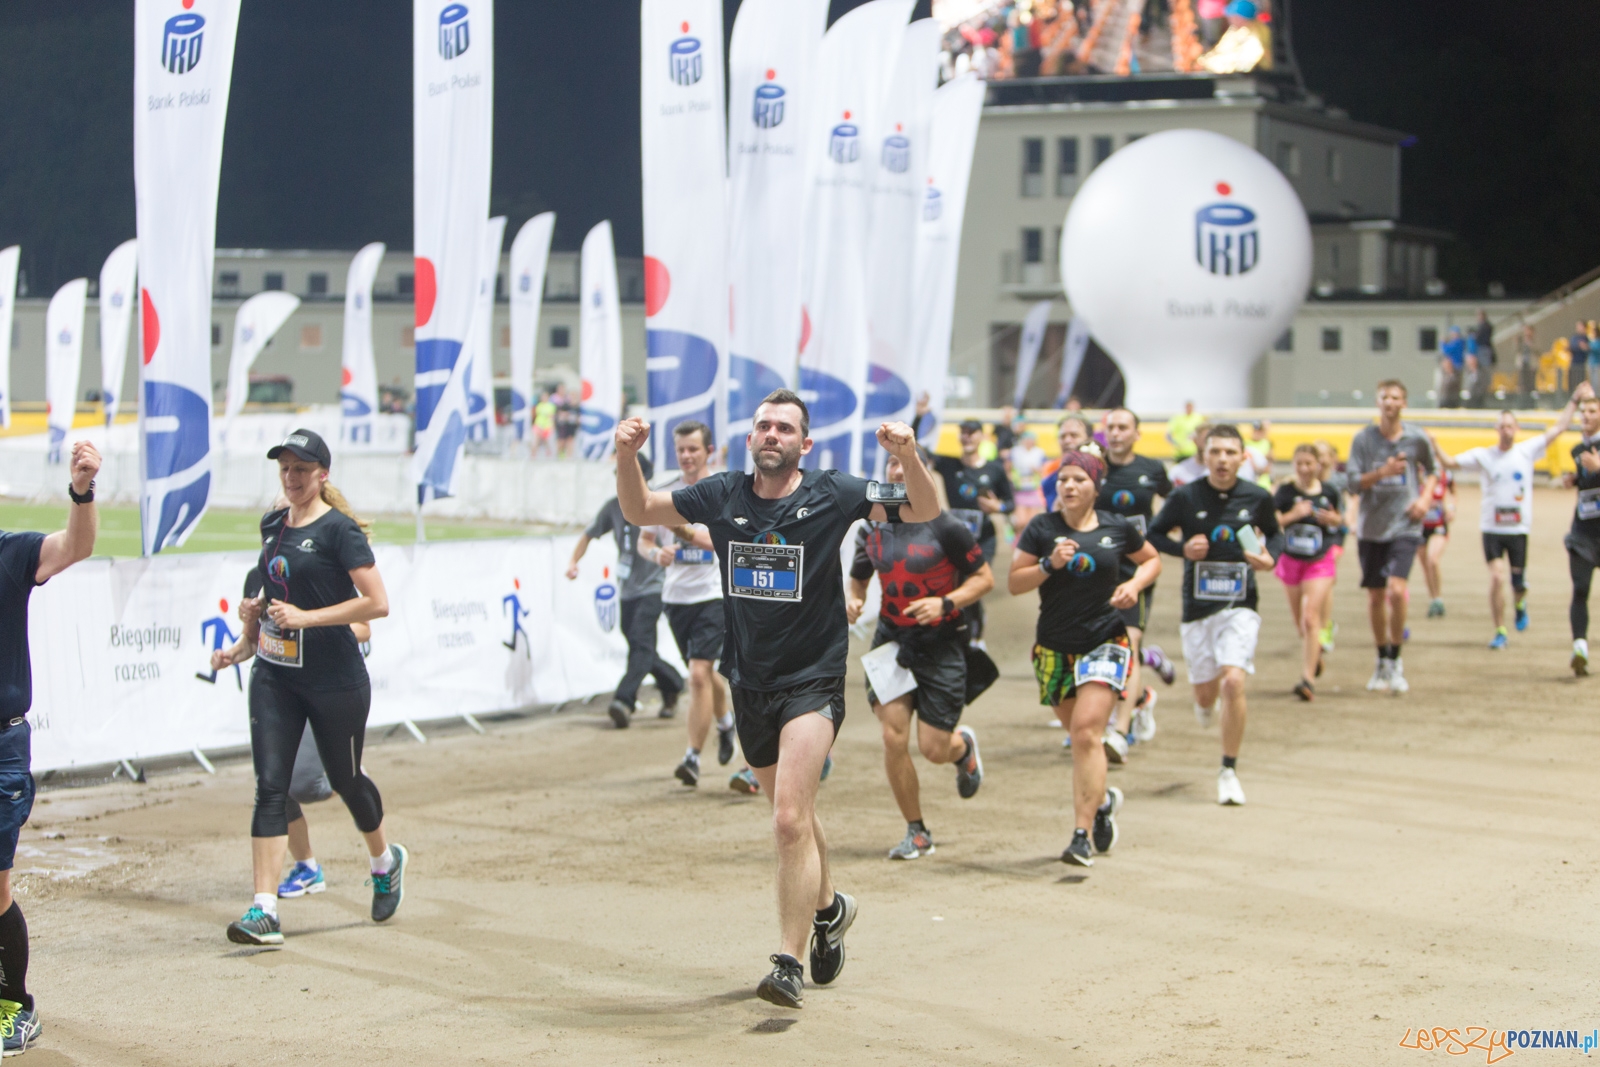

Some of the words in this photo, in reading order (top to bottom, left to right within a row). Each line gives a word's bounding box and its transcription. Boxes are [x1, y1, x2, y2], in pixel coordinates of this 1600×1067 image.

[161, 13, 206, 74] PKO
[147, 92, 175, 112] Bank
[179, 87, 212, 107] Polski
[1195, 202, 1260, 276] PKO
[752, 570, 774, 588] 151
[431, 597, 489, 623] Biegajmy
[110, 622, 181, 652] Biegajmy
[264, 636, 285, 655] 2155
[437, 631, 476, 649] razem
[115, 662, 160, 682] razem
